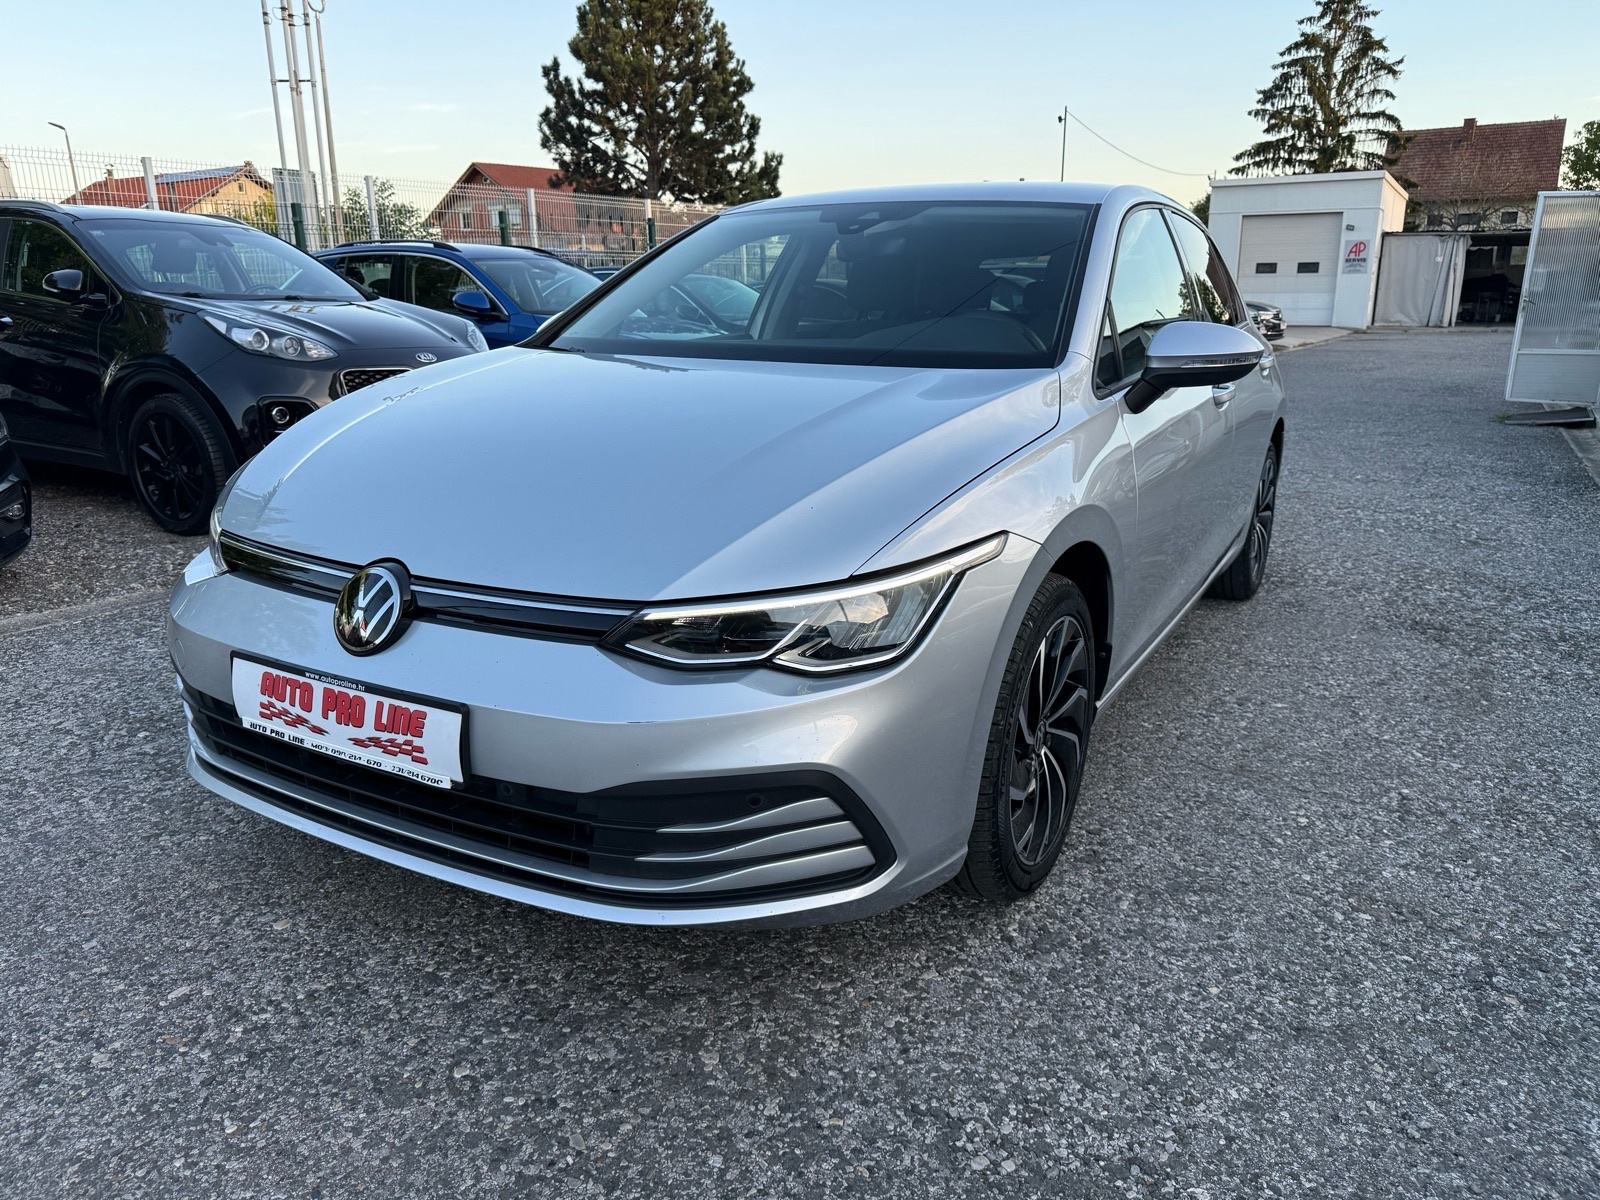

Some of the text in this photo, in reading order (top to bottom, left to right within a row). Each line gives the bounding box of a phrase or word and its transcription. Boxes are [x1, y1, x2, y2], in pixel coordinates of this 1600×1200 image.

[1347, 241, 1367, 257] AP
[305, 671, 366, 691] www.autoproline.hr
[260, 671, 428, 738] AUTO PRO LINE
[270, 728, 285, 739] PRO
[288, 734, 305, 745] LINE
